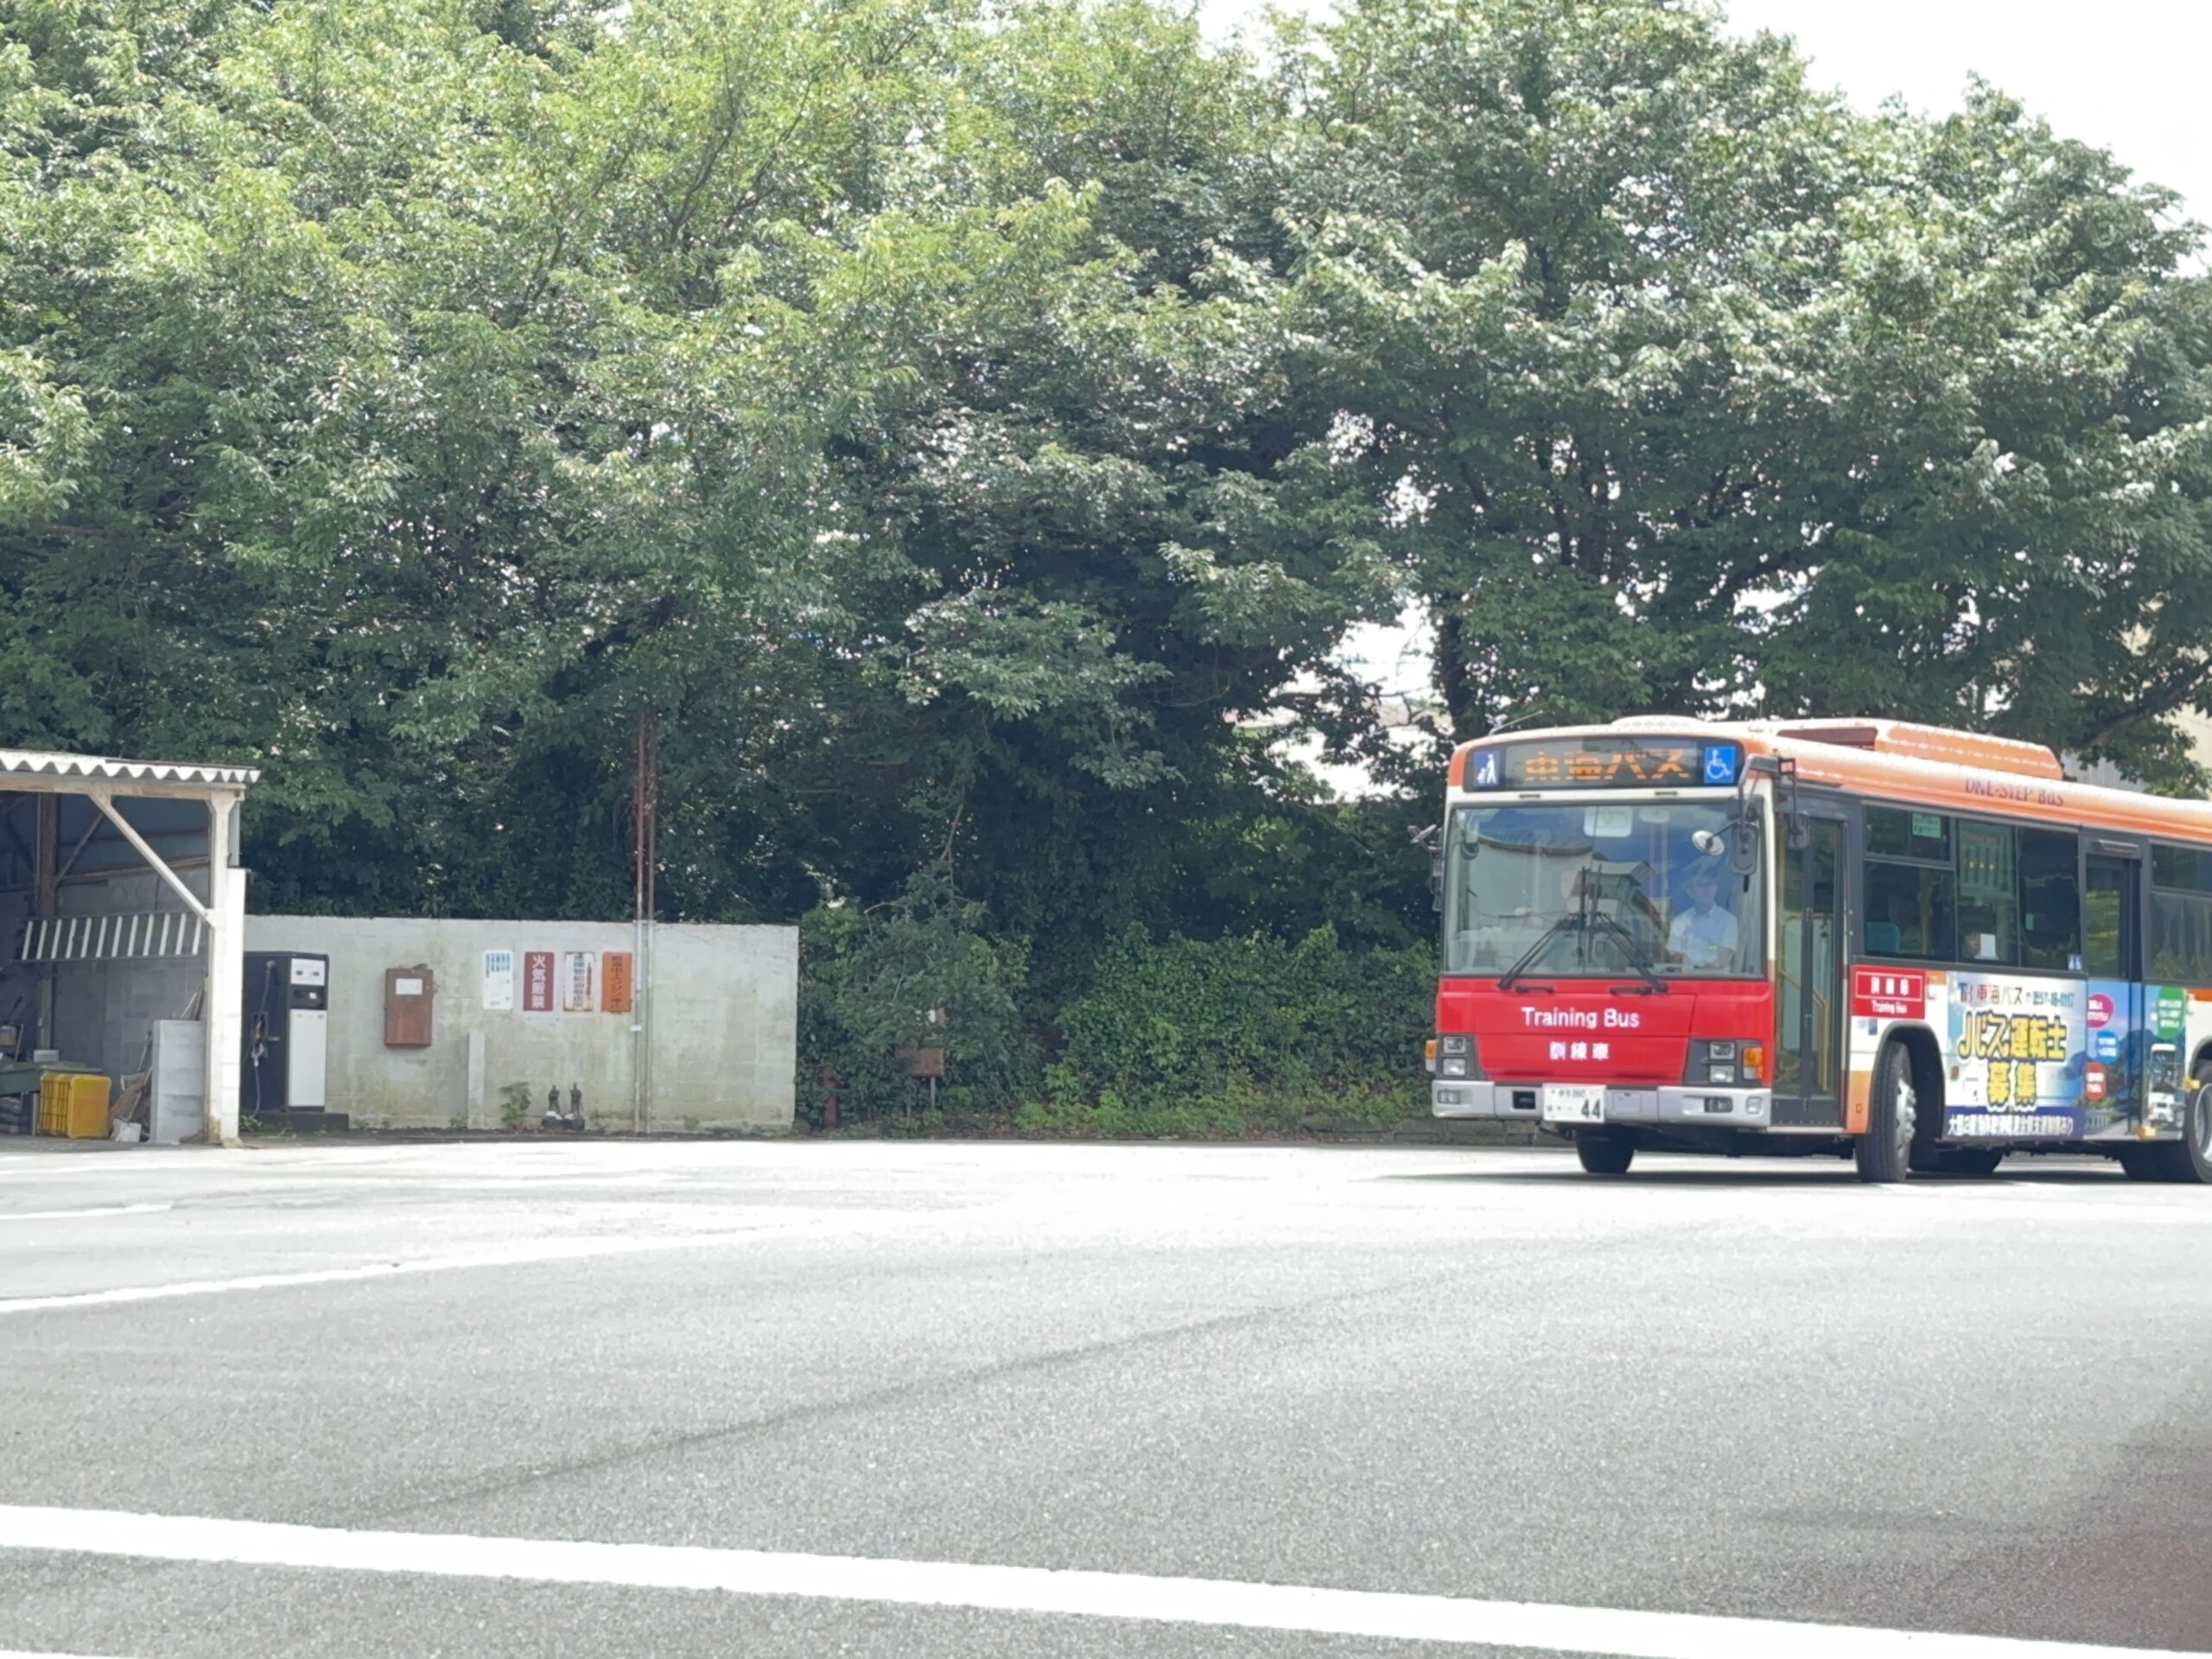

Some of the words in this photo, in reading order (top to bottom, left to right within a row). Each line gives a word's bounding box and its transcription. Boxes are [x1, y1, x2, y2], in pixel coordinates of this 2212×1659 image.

[531, 955, 547, 1009] 火気厳禁
[1521, 1007, 1598, 1029] Training
[1604, 1007, 1640, 1027] Bus
[1958, 1009, 2067, 1062] バス運転士
[1987, 1060, 2037, 1106] 募集
[1580, 1098, 1601, 1119] 44
